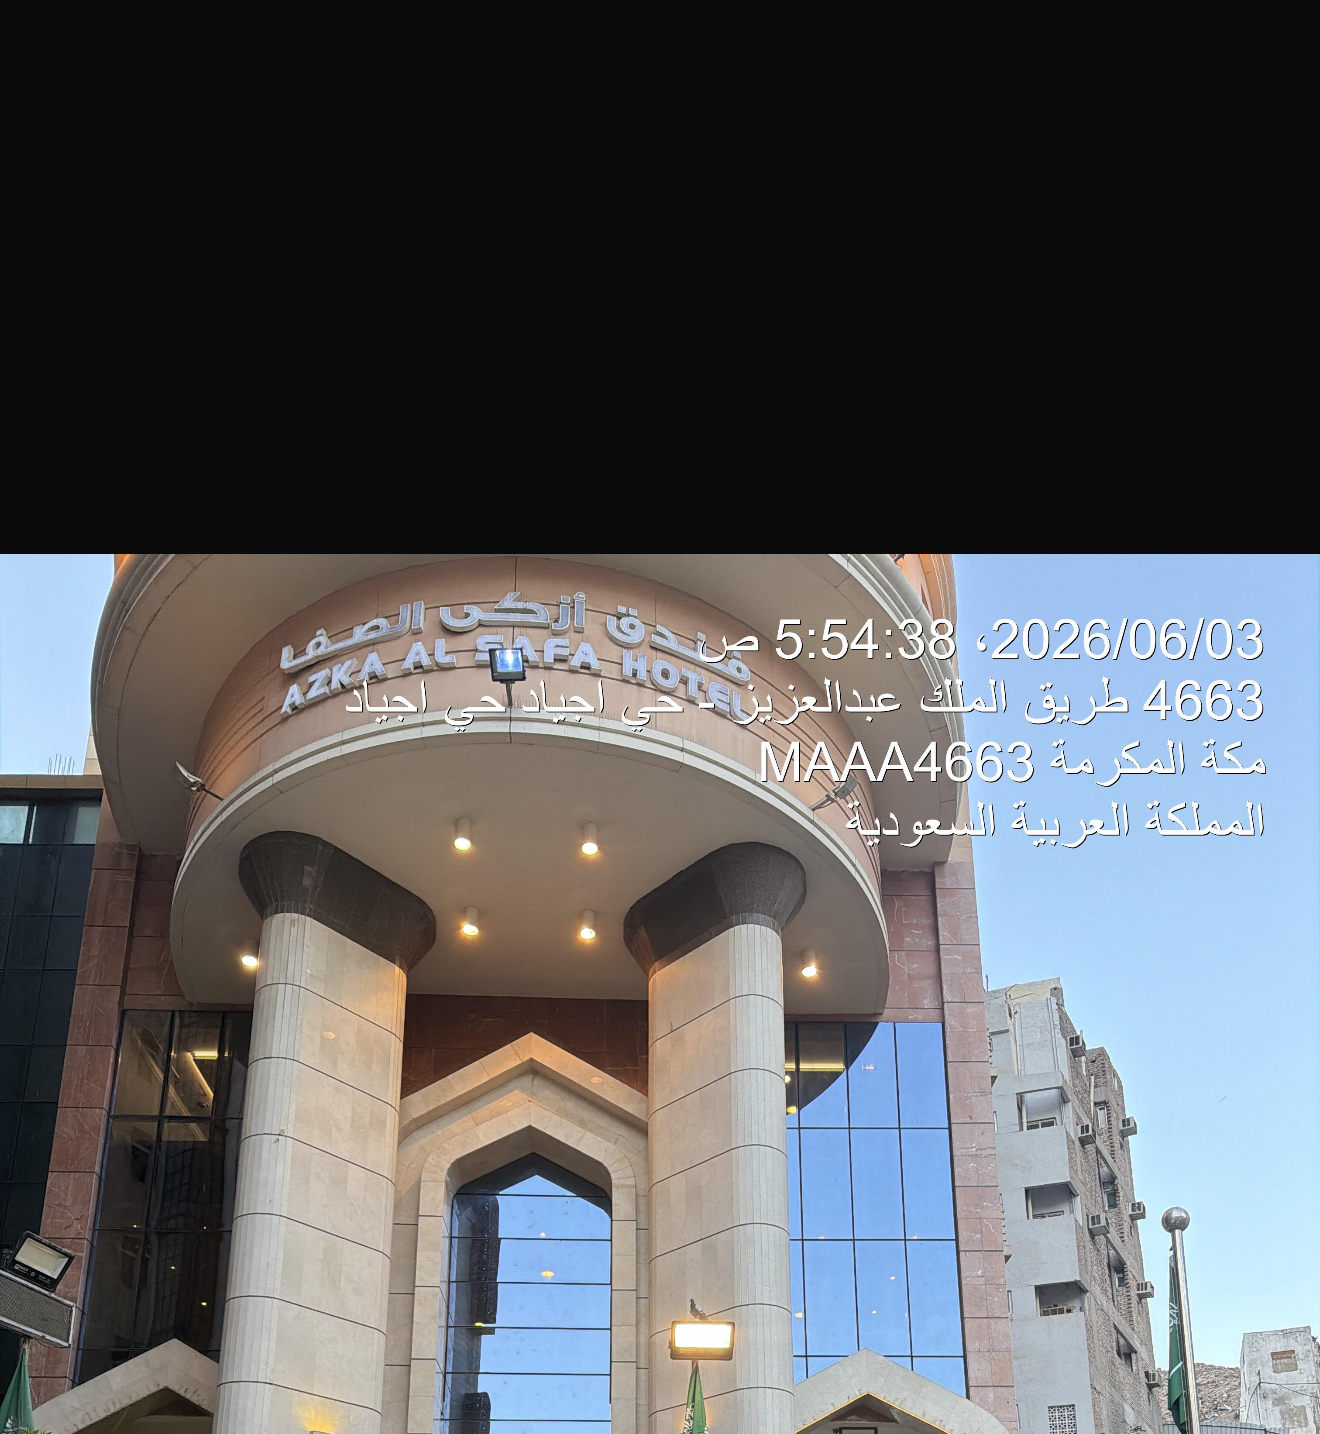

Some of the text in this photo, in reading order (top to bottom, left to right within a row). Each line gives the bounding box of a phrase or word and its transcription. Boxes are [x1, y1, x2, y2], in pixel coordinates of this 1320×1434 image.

[279, 591, 751, 686] فندق أزكى الصفا
[280, 651, 387, 718] AZKA
[401, 639, 458, 672] AL
[622, 649, 752, 724] HOTEL
